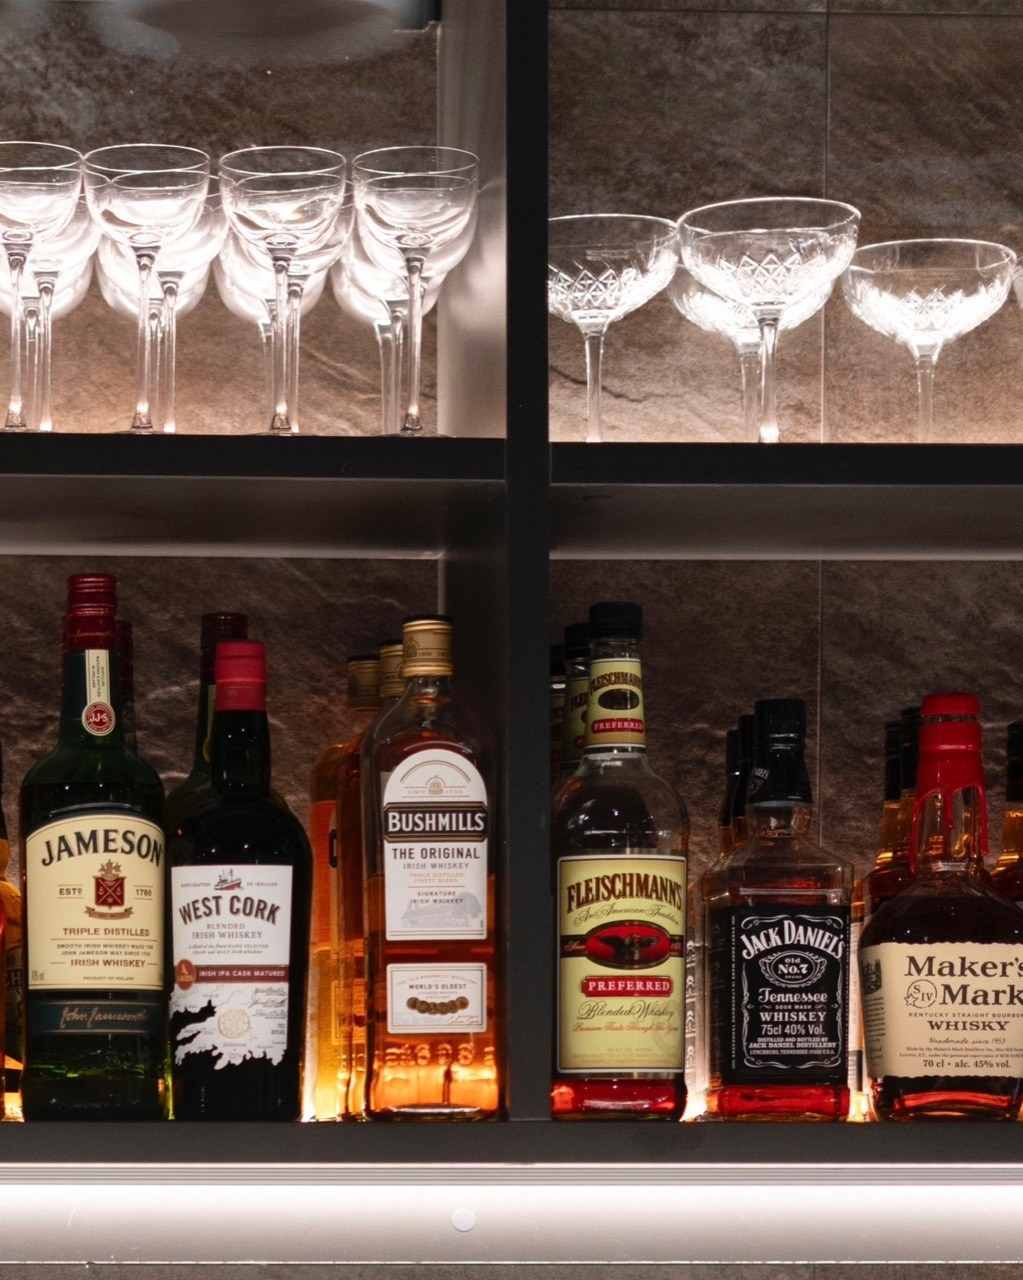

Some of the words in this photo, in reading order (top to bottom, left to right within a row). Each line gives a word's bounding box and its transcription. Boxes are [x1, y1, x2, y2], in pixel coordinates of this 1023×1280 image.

[387, 812, 486, 832] BUSHMILLS
[41, 829, 163, 868] JAMESON
[391, 848, 415, 860] THE
[420, 847, 480, 860] ORIGINAL
[430, 862, 470, 870] WHISKEY
[135, 888, 152, 897] 1780
[566, 872, 682, 914] FLEISCHMANN'S
[178, 894, 223, 926] WEST
[228, 894, 282, 926] CORK
[594, 903, 645, 922] American
[62, 927, 101, 936] TRIPLE
[103, 927, 150, 937] DISTILLED
[192, 931, 216, 940] IRISH
[218, 931, 263, 939] WHISKEY
[740, 927, 780, 960] JACK
[782, 919, 846, 960] DANIEL'S
[70, 959, 100, 967] IRISH
[102, 959, 146, 968] WHISKEY
[778, 963, 808, 974] No.7
[588, 981, 670, 991] PREFERRED
[758, 987, 828, 1003] Tennessee
[939, 983, 1023, 1006] Mark
[577, 1000, 634, 1020] Blended
[632, 1000, 675, 1020] Whiskey
[759, 1011, 827, 1022] WHISKEY
[761, 1024, 782, 1035] 75cl
[784, 1024, 806, 1035] 40%
[807, 1024, 826, 1035] Vol.
[927, 1020, 1011, 1032] WHISKY
[929, 1036, 970, 1045] Handmade
[971, 1037, 990, 1045] since
[923, 1060, 934, 1068] 70
[936, 1059, 944, 1068] cl
[954, 1059, 970, 1068] alc.
[973, 1060, 994, 1068] 45%
[995, 1060, 1011, 1068] vol.
